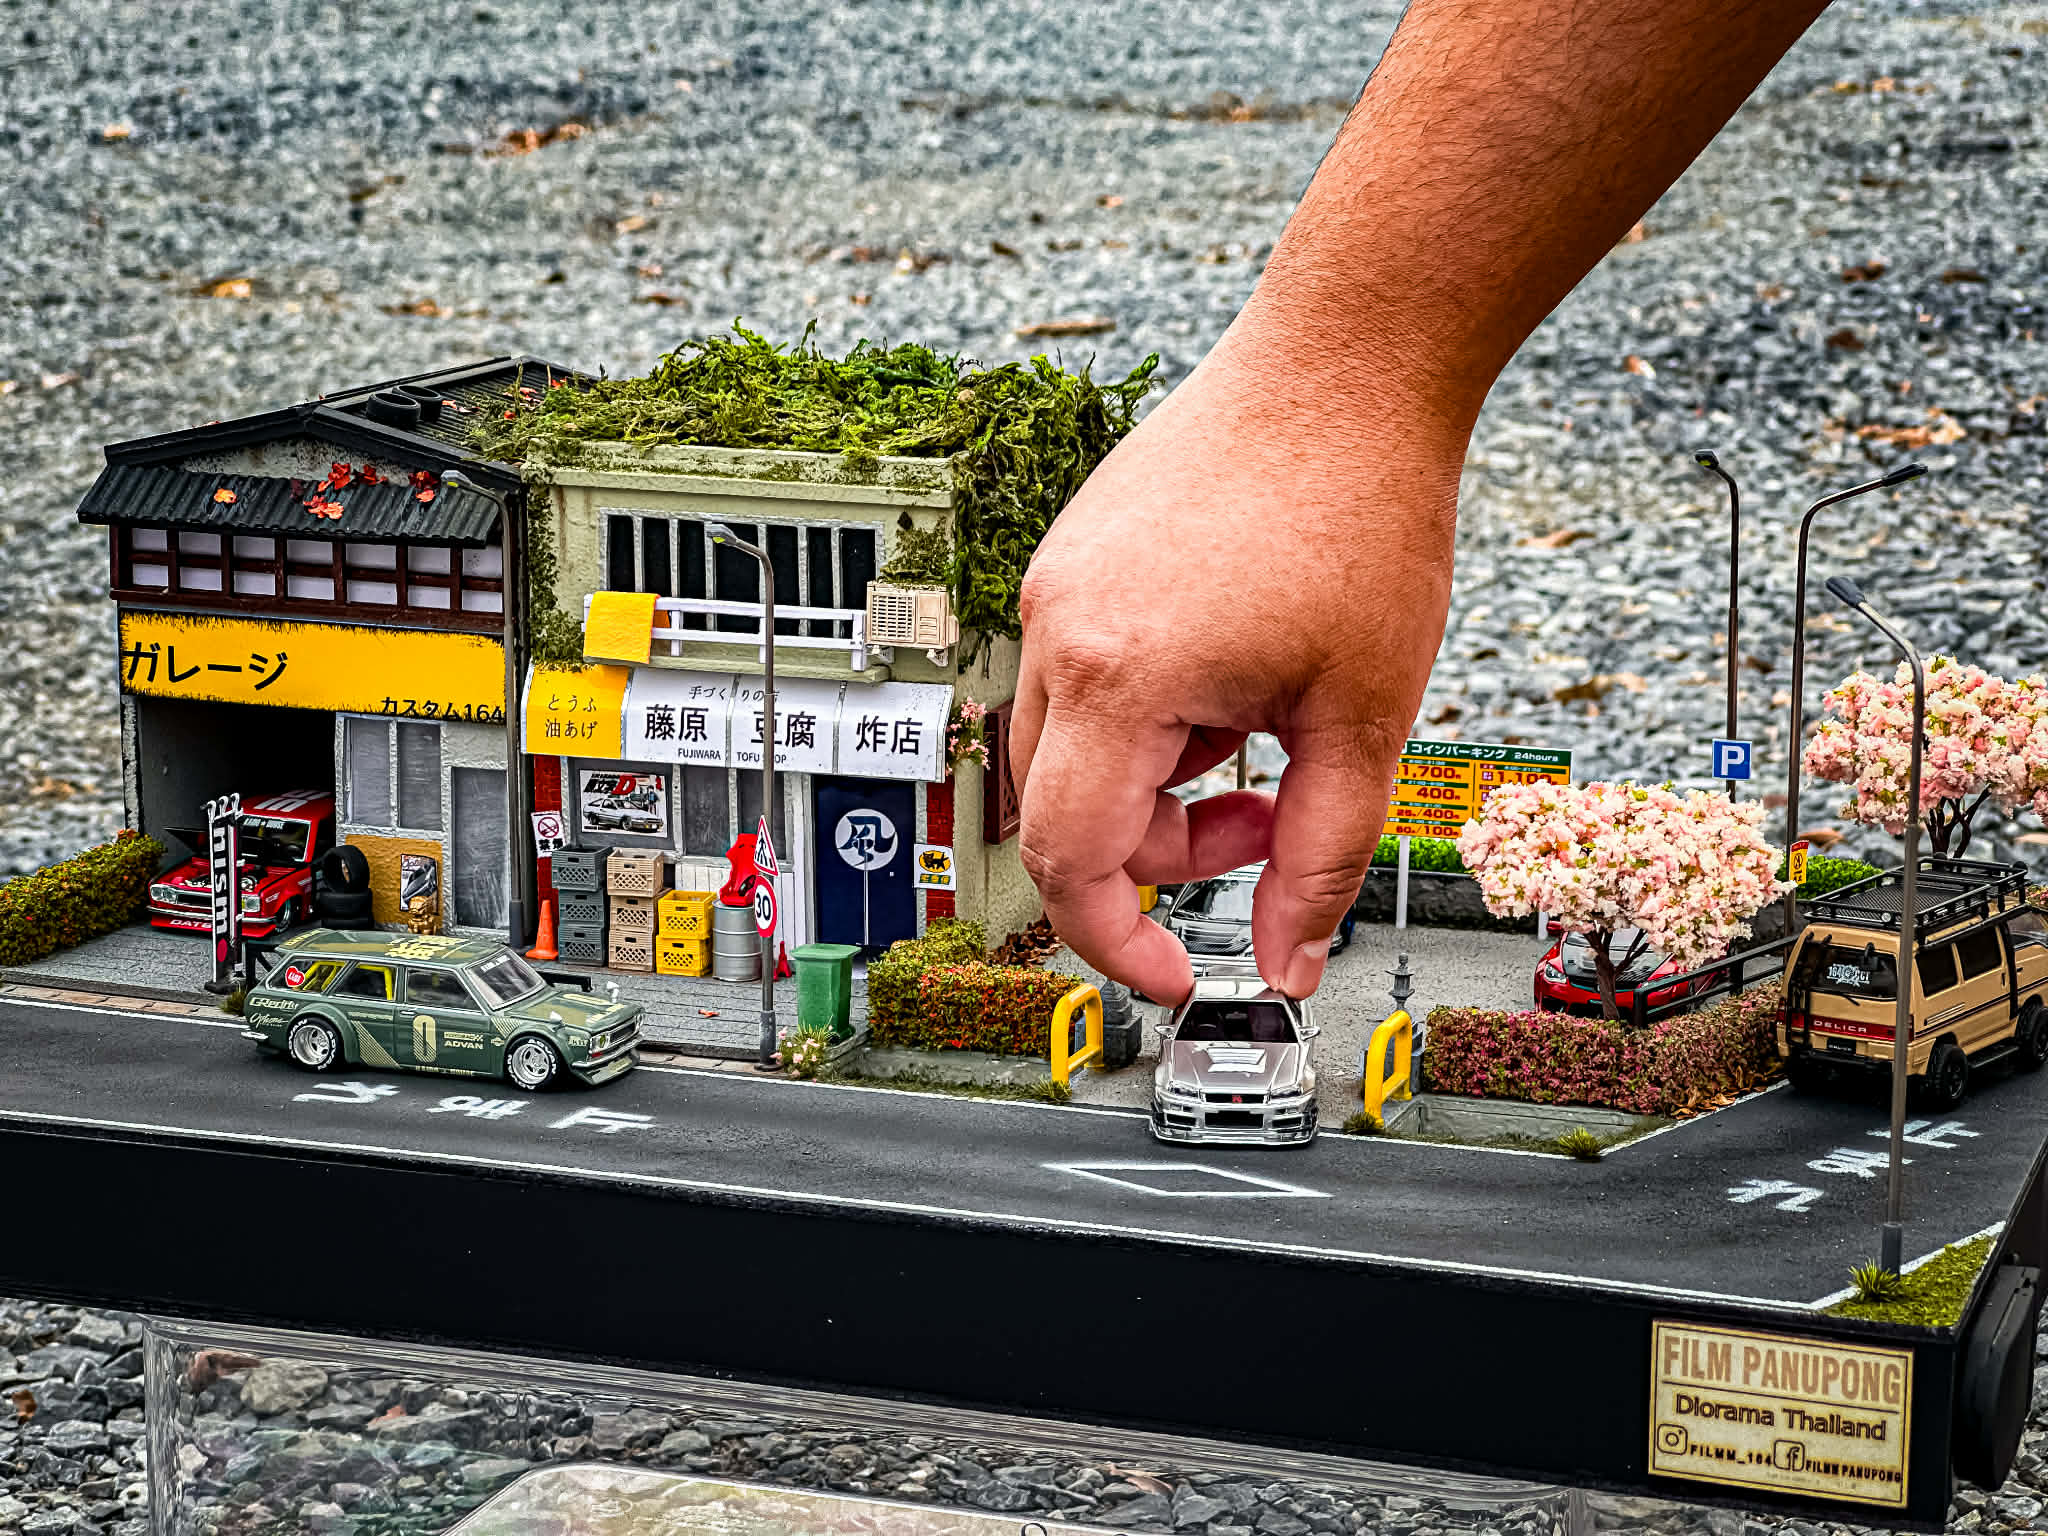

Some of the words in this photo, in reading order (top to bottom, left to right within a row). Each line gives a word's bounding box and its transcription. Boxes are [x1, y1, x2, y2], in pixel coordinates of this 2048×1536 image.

[123, 641, 288, 691] ガレージ
[548, 694, 598, 713] とうふ
[545, 718, 598, 740] 油あげ
[645, 704, 709, 743] 藤原
[678, 748, 721, 761] FUJIWARA
[737, 751, 760, 763] TOFU
[1411, 743, 1507, 760] コインパーキング
[1514, 751, 1559, 762] 24hours
[1720, 745, 1745, 776] P
[755, 893, 772, 921] 30
[169, 918, 213, 929] DATS
[1813, 1019, 1867, 1033] DELICA
[443, 1040, 484, 1051] ADVAN
[1663, 1335, 1732, 1384] FILM
[1743, 1345, 1902, 1405] PANUPONG
[1675, 1393, 1775, 1427] Diorama
[1782, 1406, 1887, 1441] Thailand
